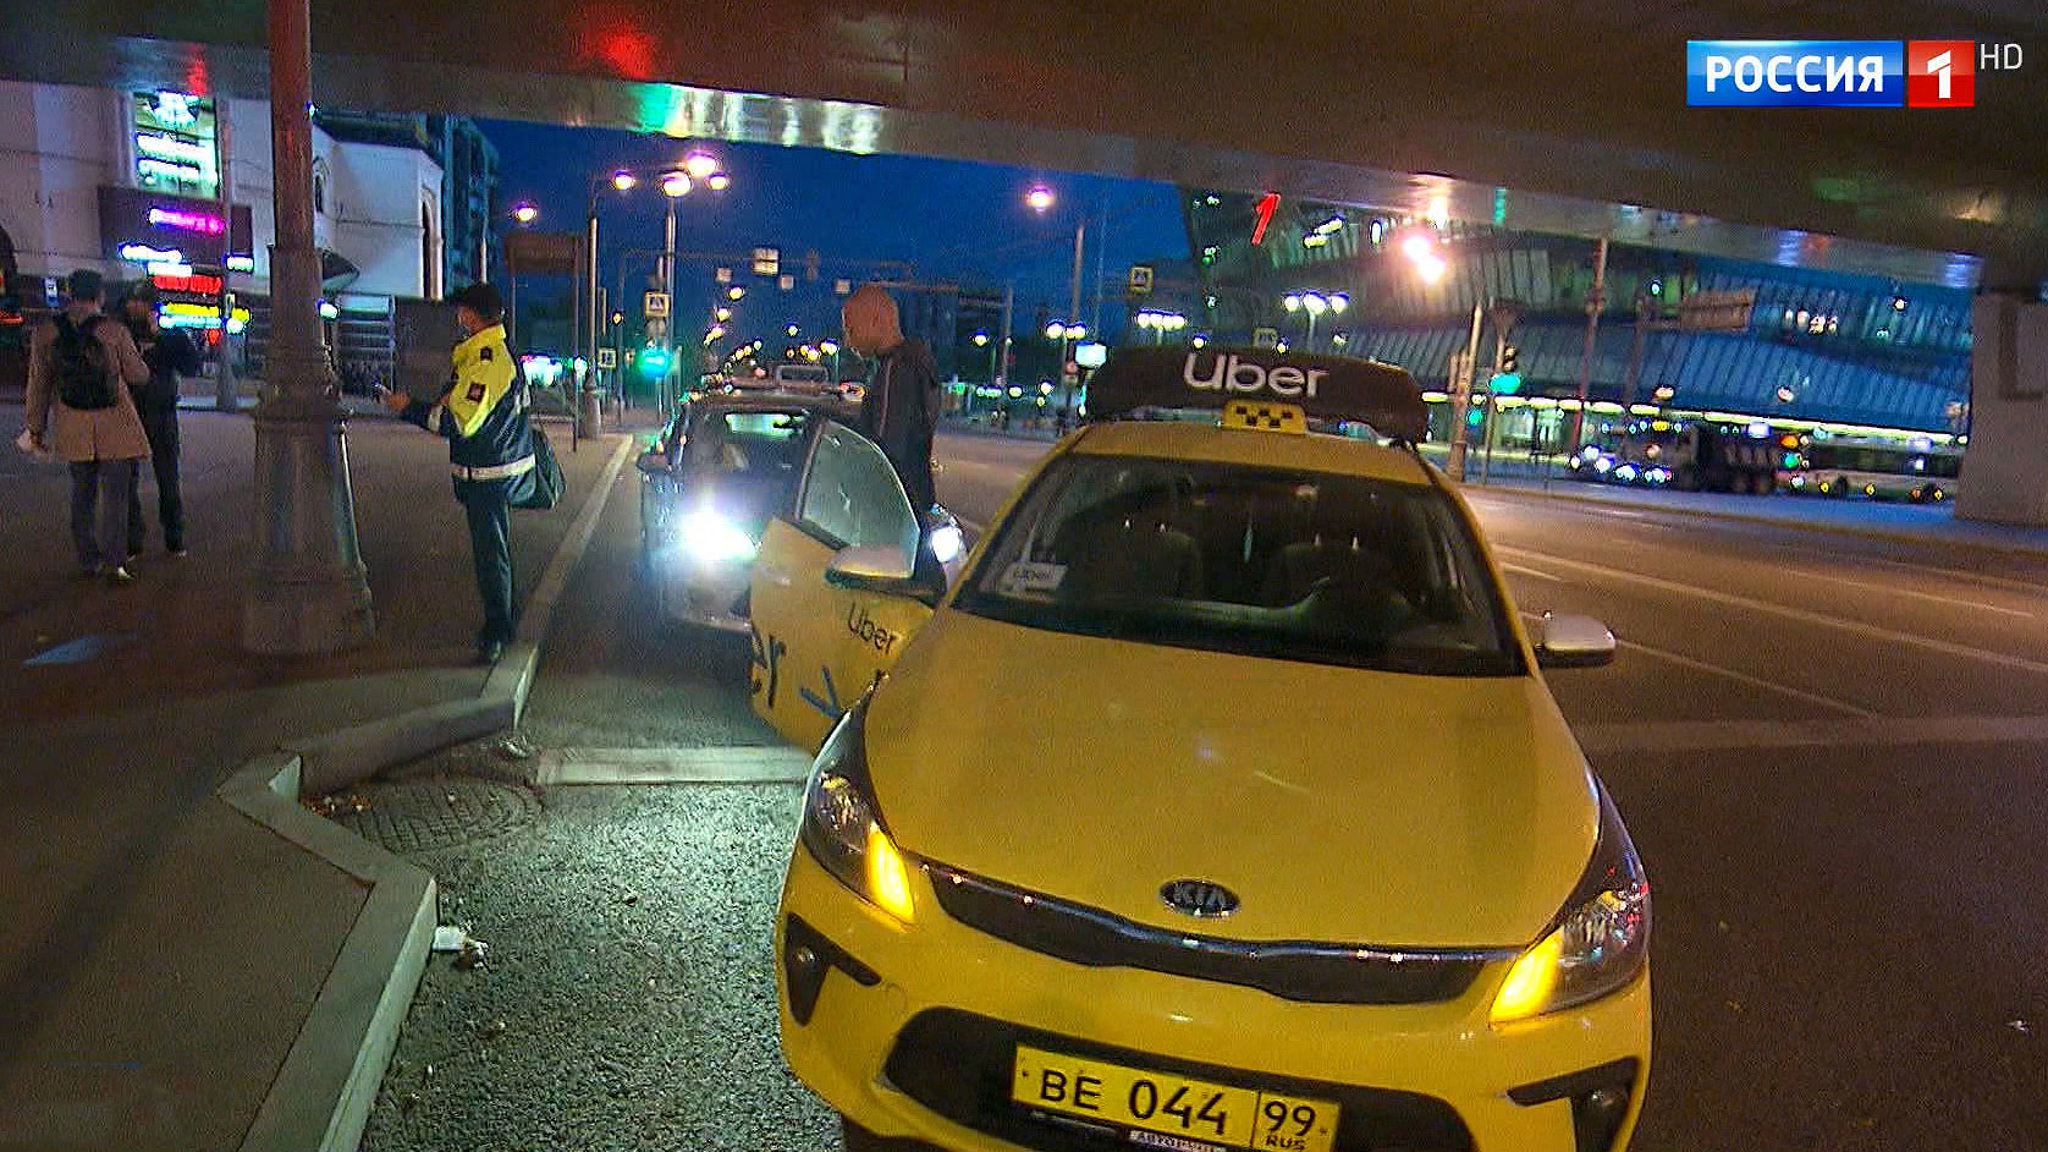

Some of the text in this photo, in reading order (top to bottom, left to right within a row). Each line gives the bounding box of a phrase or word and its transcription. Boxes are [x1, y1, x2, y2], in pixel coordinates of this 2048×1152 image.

[1183, 352, 1330, 397] Uber
[848, 602, 896, 655] Uber
[1128, 1080, 1227, 1135] 044
[1264, 1101, 1316, 1137] 99
[1265, 1134, 1307, 1152] RUS
